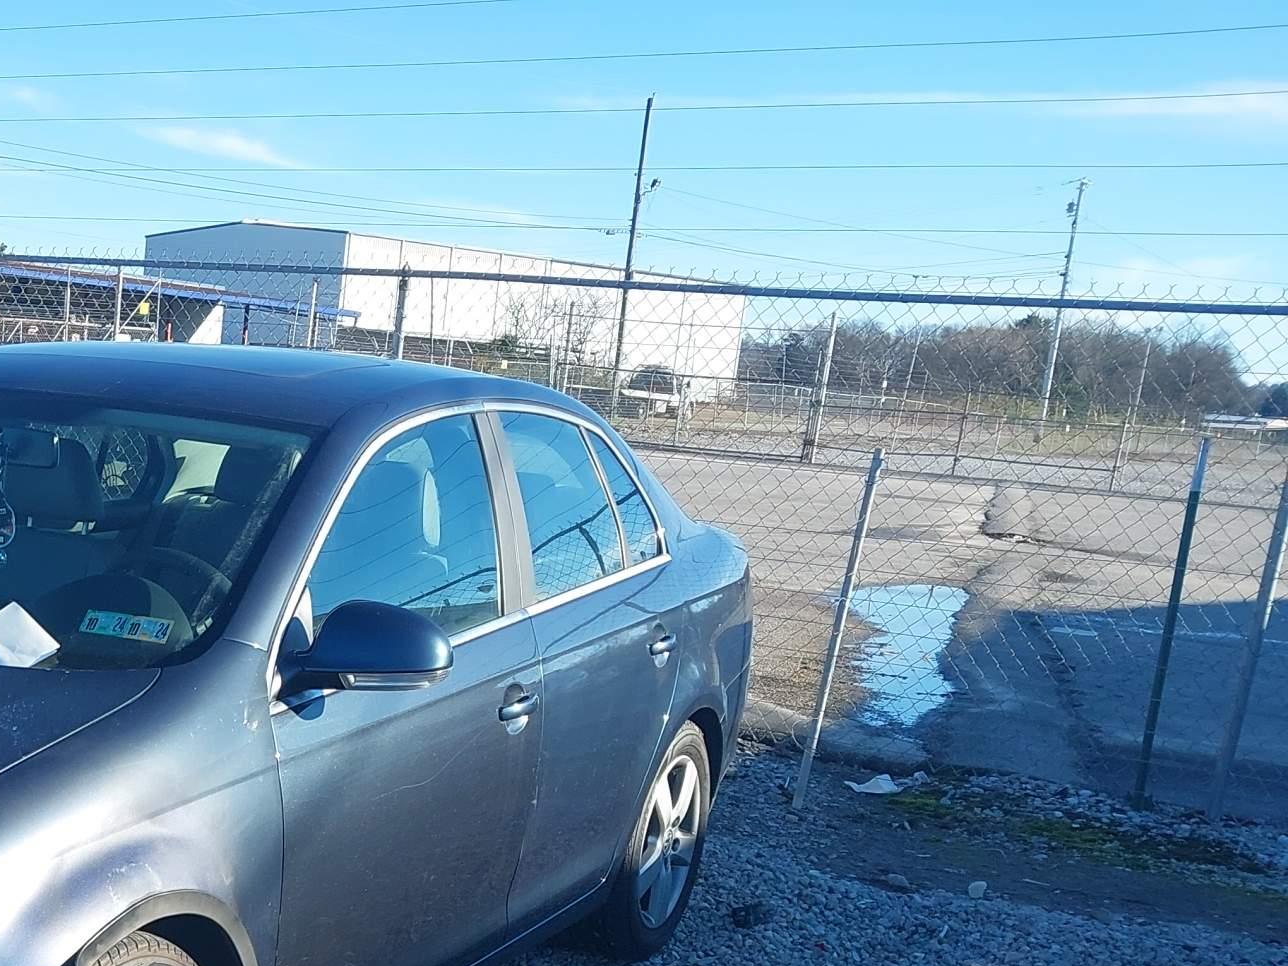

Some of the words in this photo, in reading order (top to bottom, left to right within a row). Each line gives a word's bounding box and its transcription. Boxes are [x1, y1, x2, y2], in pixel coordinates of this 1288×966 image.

[86, 617, 99, 631] 10
[112, 616, 128, 632] 24
[128, 622, 141, 636] 10
[155, 623, 170, 639] 24
